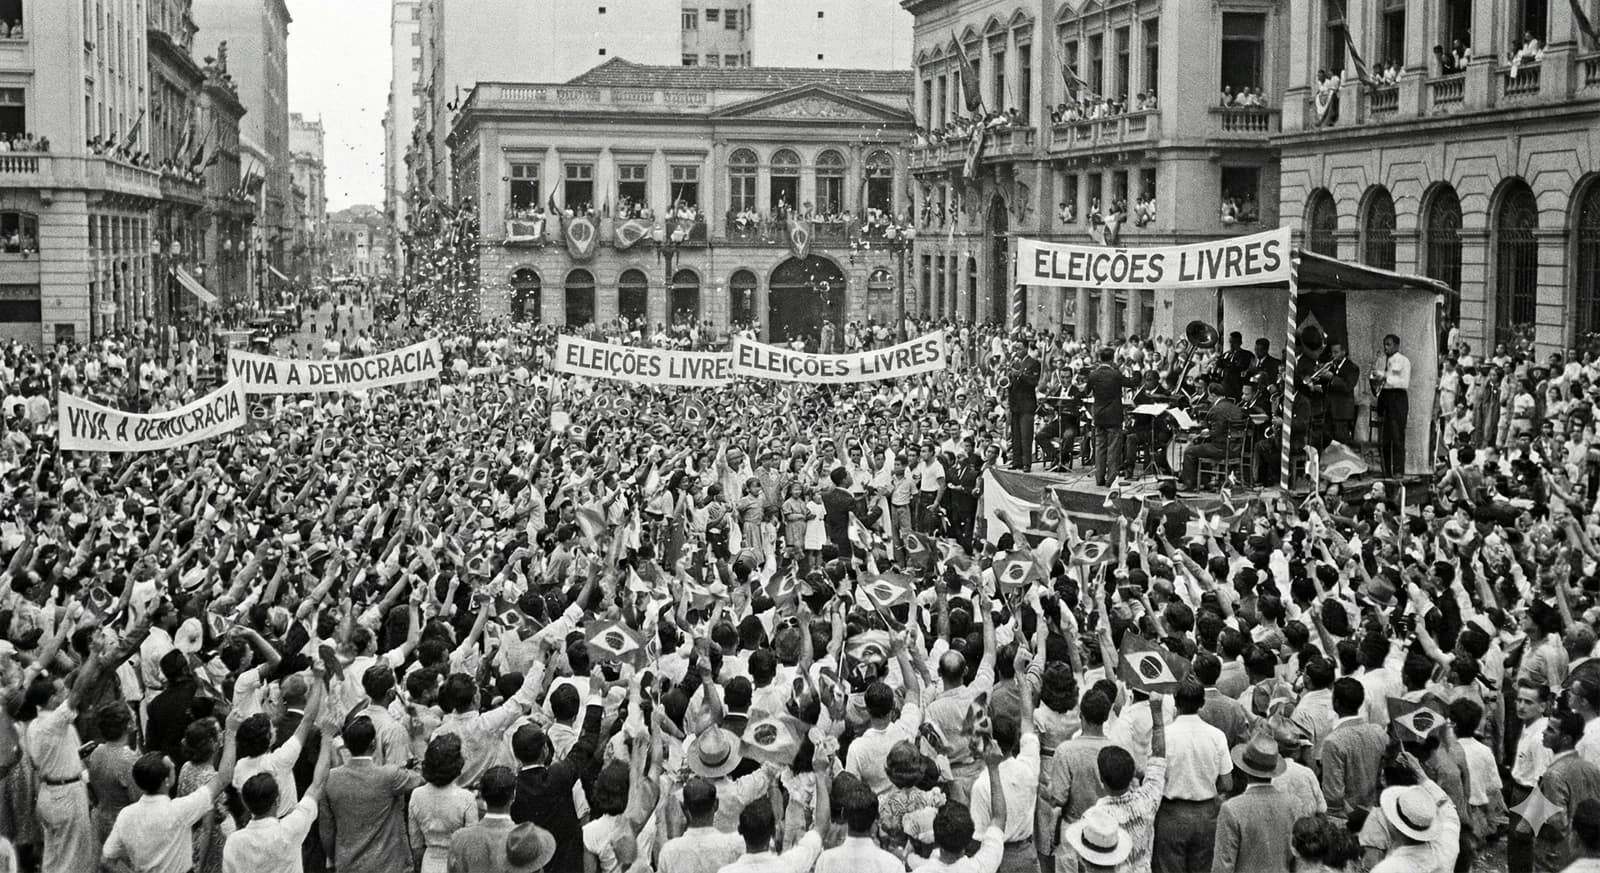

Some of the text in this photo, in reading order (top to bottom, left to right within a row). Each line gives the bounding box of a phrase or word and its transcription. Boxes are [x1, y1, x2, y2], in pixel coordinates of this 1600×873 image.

[1034, 239, 1281, 286] ELEIÇÕES LIVRES
[231, 347, 436, 385] VIVA A DEMOCRACIA
[566, 343, 661, 377] ELEIÇÕES
[738, 340, 940, 378] ELEIÇÕES LIVRES
[67, 406, 111, 441] VIVA
[116, 416, 129, 442] A
